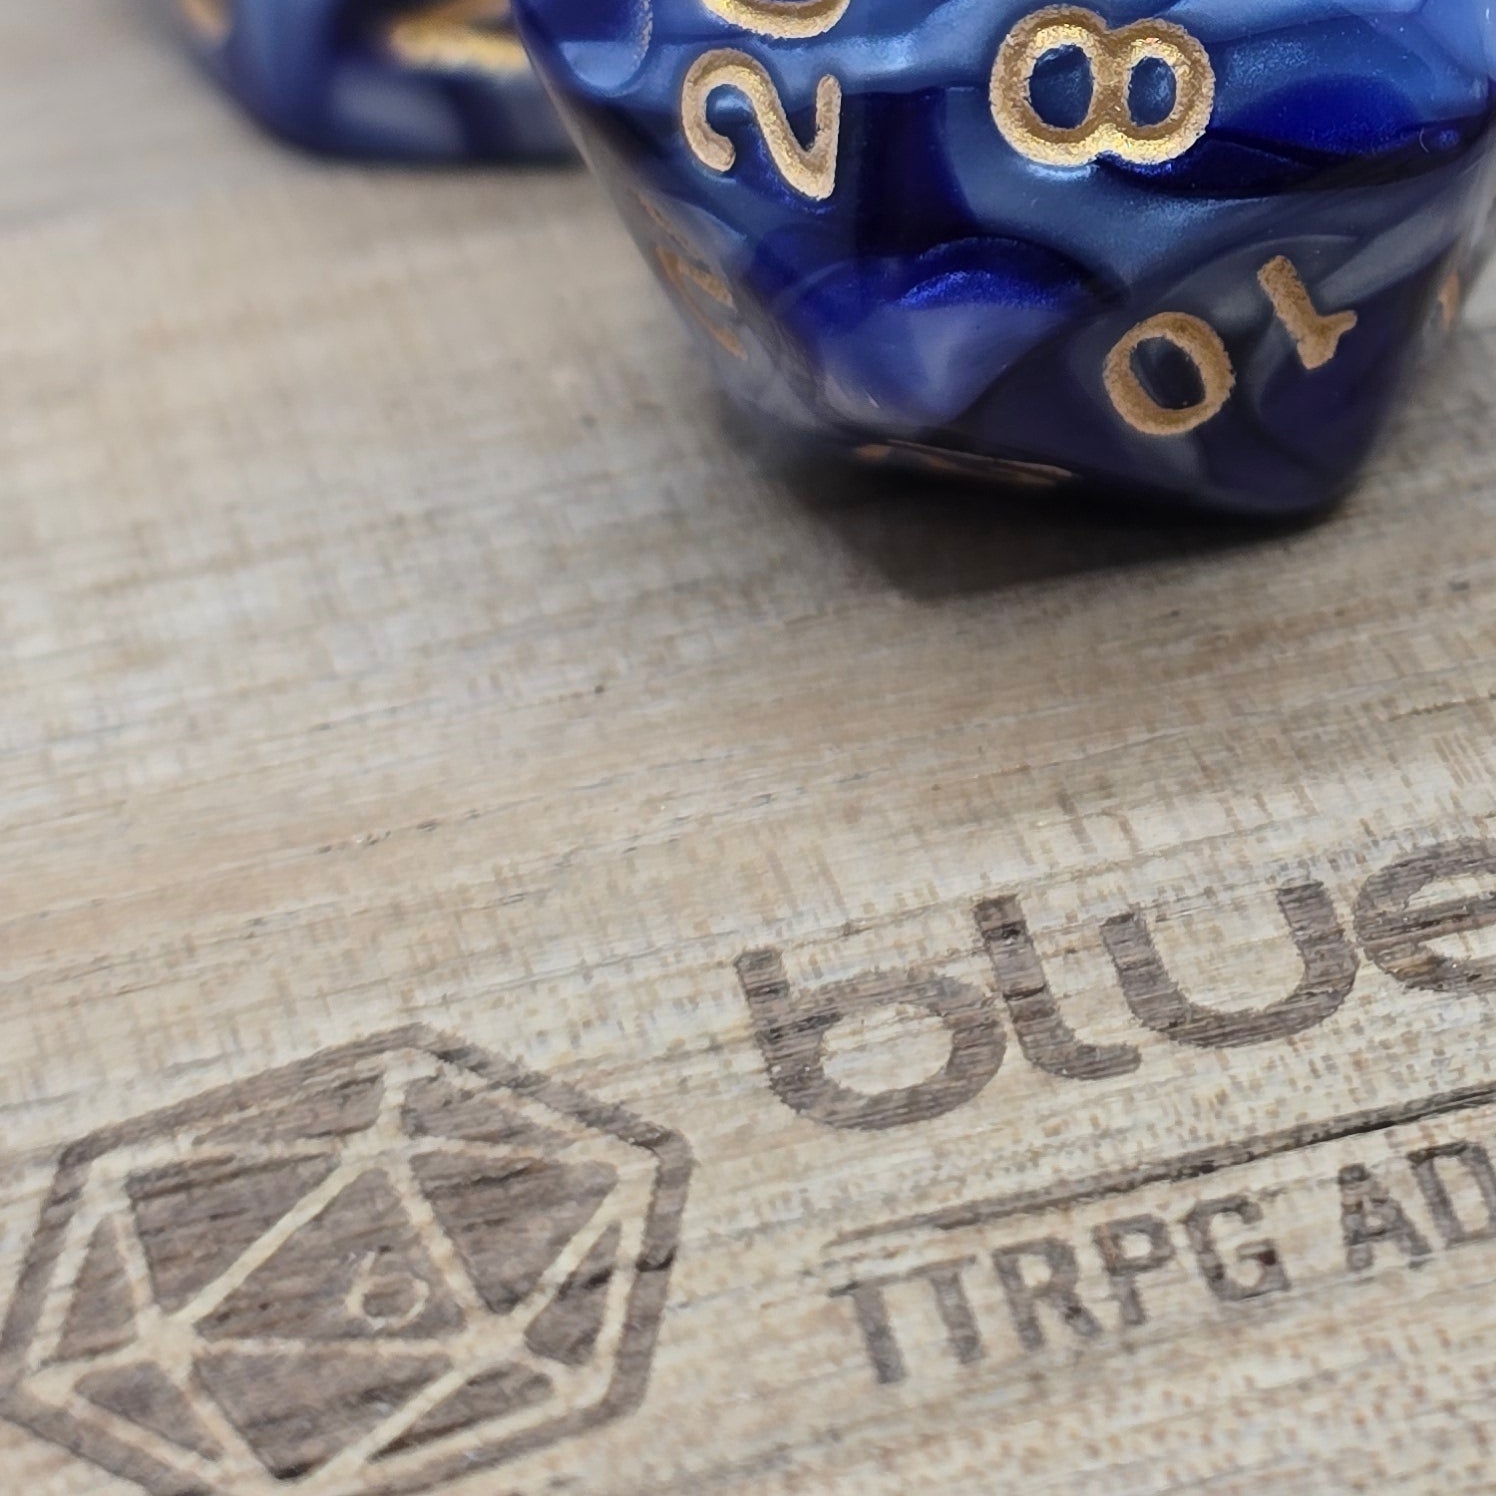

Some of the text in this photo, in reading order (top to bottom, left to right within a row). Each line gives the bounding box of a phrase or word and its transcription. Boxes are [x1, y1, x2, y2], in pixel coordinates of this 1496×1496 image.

[989, 3, 1216, 168] 8
[1100, 254, 1360, 439] 10
[828, 1189, 1293, 1386] TTRPG
